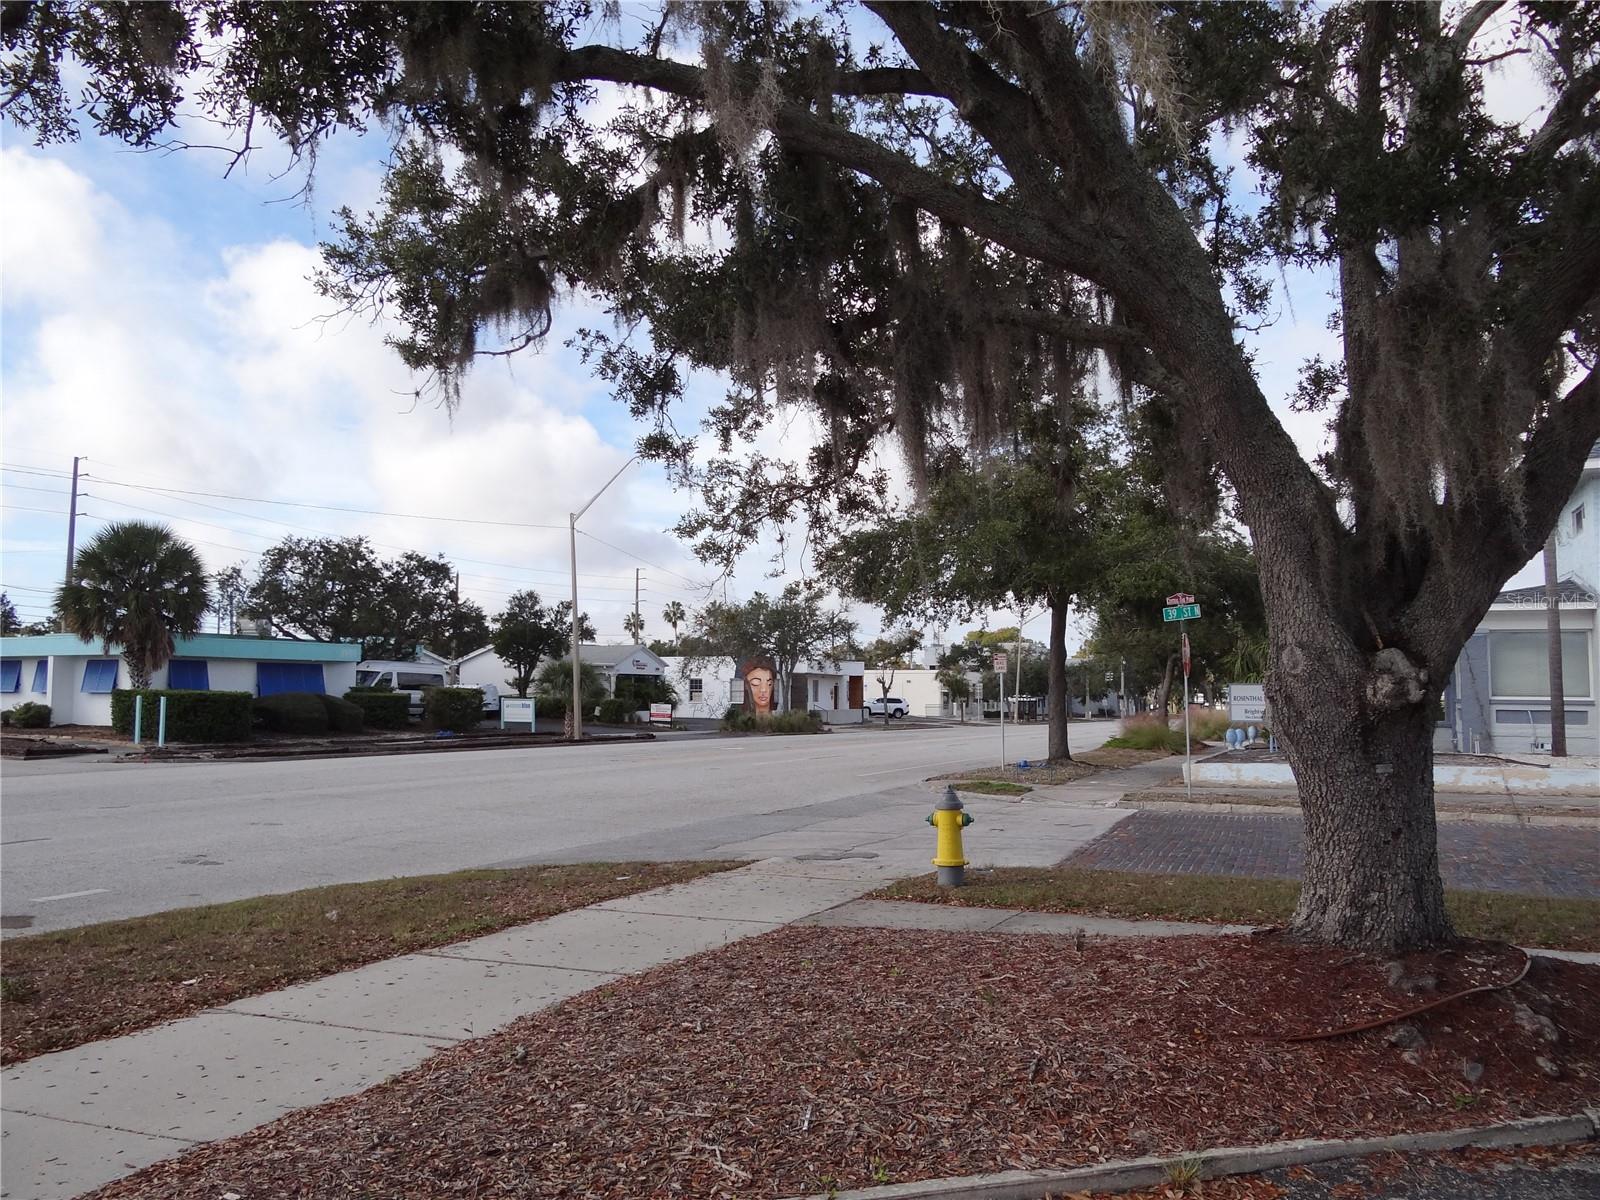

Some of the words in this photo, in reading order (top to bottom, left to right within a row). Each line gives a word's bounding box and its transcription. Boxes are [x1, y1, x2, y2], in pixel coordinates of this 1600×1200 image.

[1167, 608, 1177, 619] 39
[1183, 606, 1191, 617] ST
[1194, 605, 1200, 617] N
